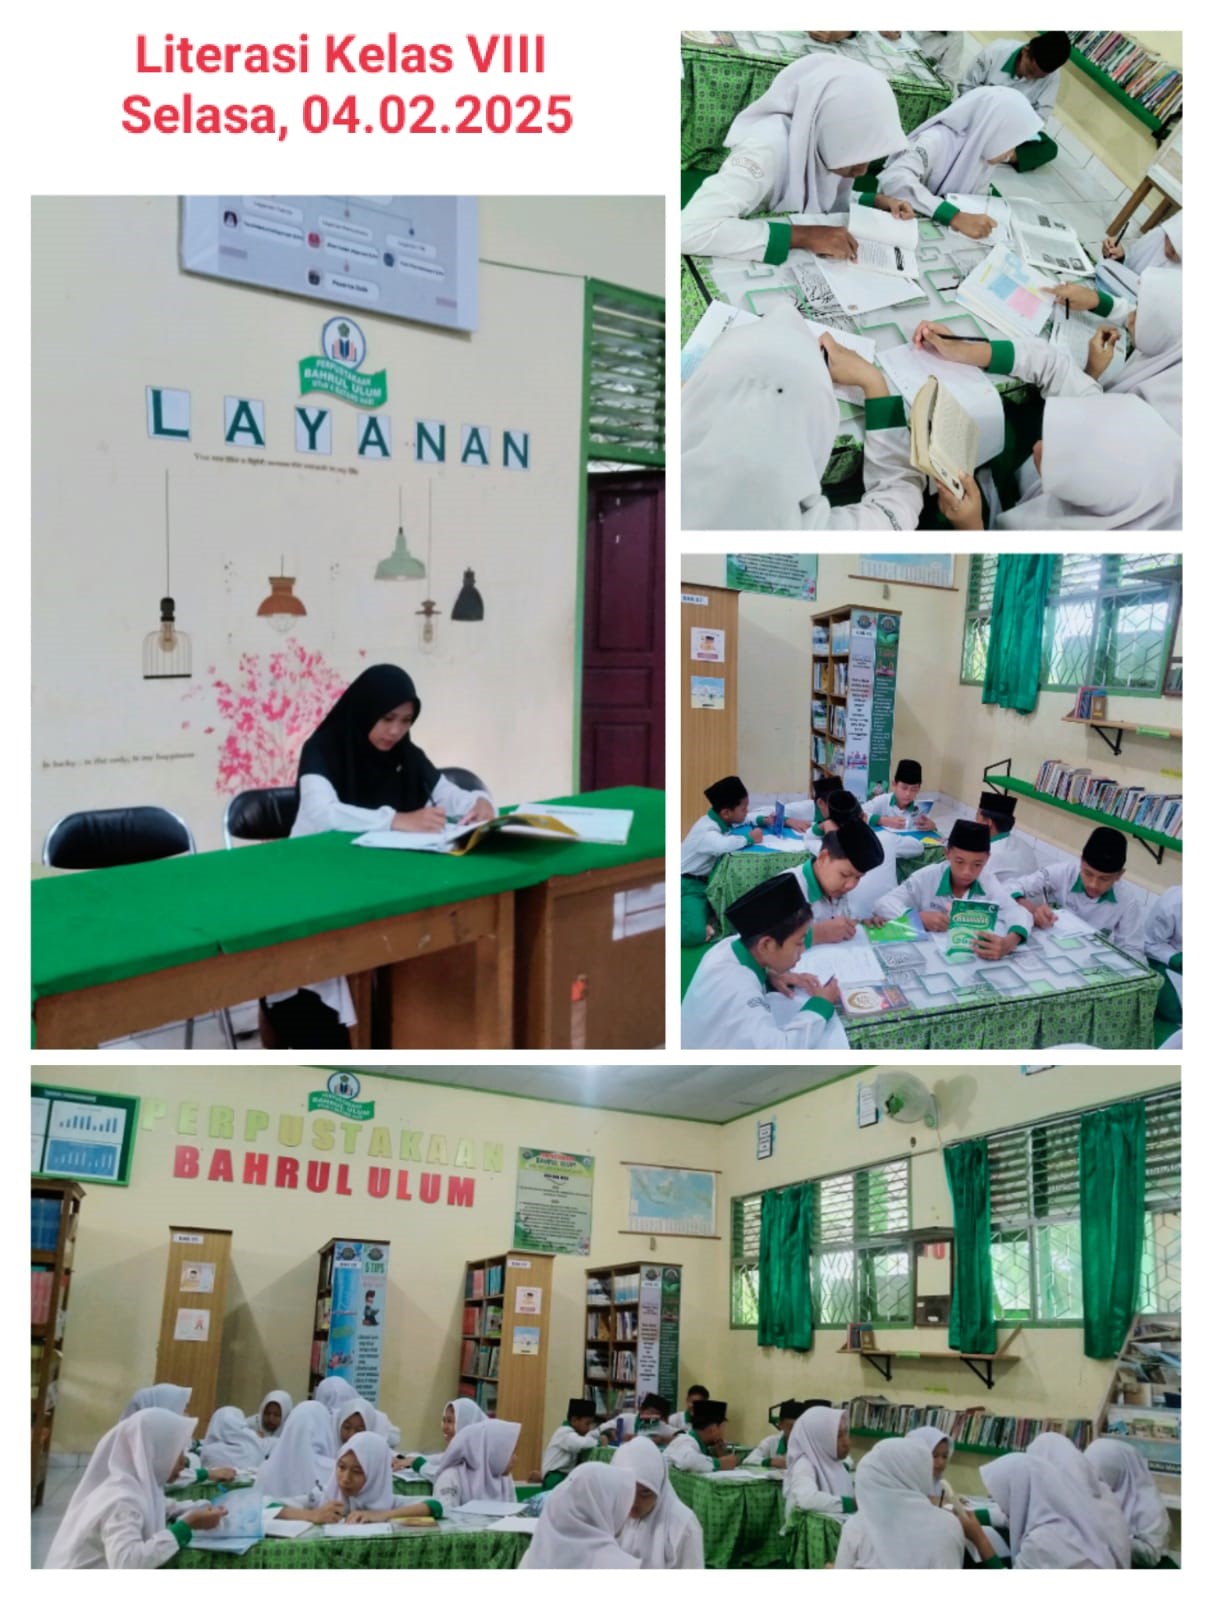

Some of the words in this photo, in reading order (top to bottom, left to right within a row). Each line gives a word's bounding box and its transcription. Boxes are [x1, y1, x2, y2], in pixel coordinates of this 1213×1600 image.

[303, 368, 349, 390] BAHRUL
[351, 383, 382, 398] ULUM
[150, 388, 529, 469] LAYANAN
[140, 1100, 505, 1174] PERPUSTAKAAN
[172, 1144, 353, 1196] BAHRUL
[367, 1165, 476, 1208] ULUM
